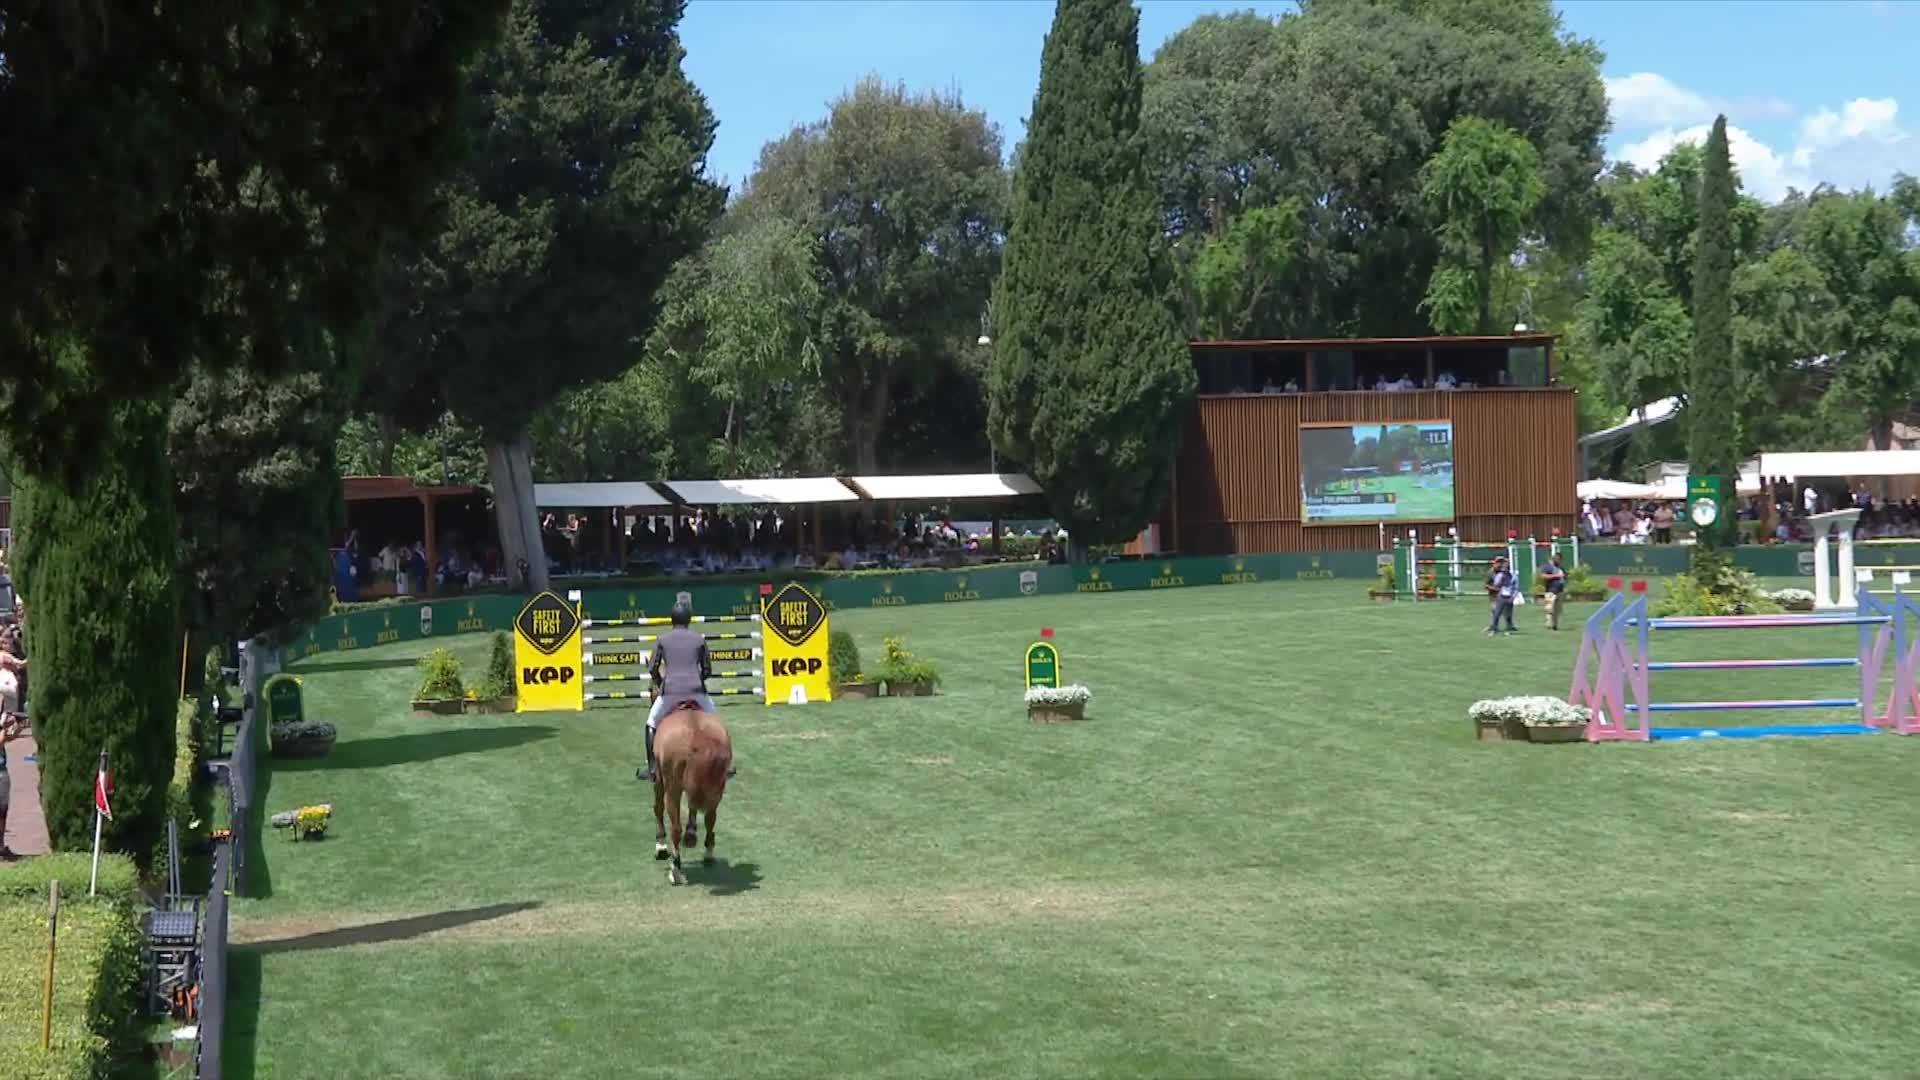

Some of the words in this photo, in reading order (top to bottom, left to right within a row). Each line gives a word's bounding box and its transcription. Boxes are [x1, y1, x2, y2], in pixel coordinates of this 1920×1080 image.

[1221, 571, 1257, 585] ROLEX
[1297, 569, 1334, 579] ROLEX
[1077, 581, 1113, 592] ROLEX
[1151, 576, 1185, 588] ROLEX
[872, 595, 906, 606] ROLEX
[944, 589, 980, 601] ROLEX
[780, 601, 808, 612] SAFETY
[533, 609, 560, 620] SAFETY
[780, 612, 808, 626] FIRST
[533, 620, 561, 635] FIRST
[594, 655, 620, 664] THINK
[620, 653, 640, 663] SAFE
[709, 651, 733, 660] THINK
